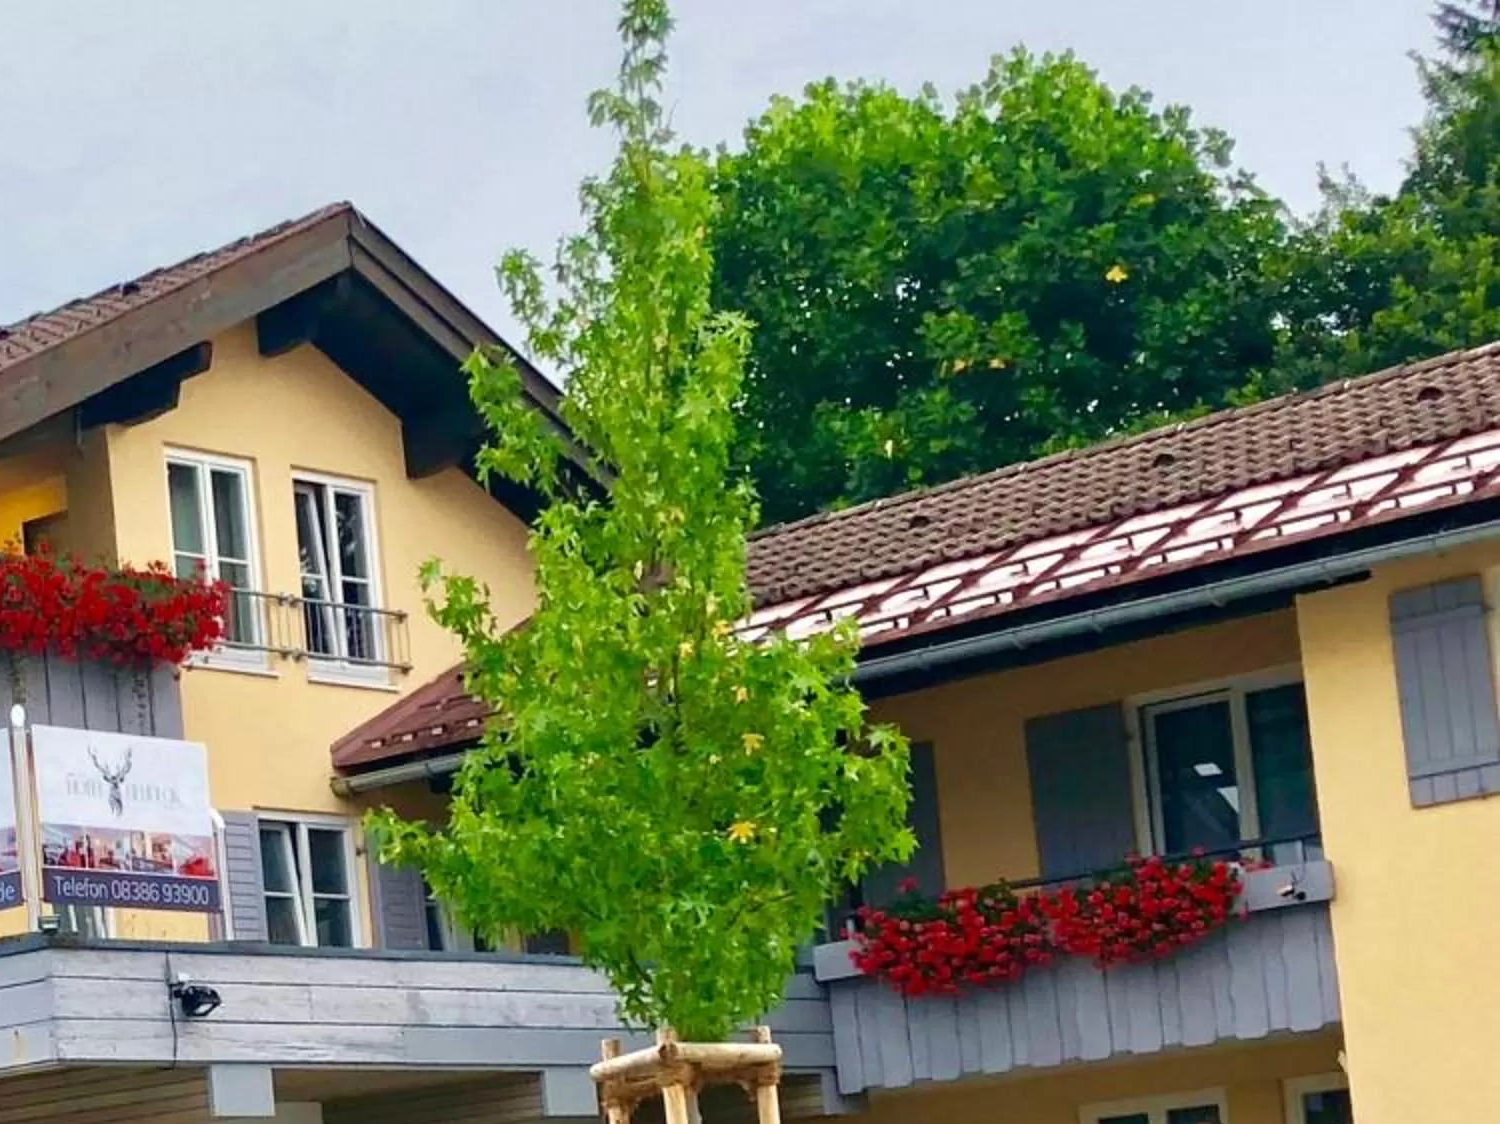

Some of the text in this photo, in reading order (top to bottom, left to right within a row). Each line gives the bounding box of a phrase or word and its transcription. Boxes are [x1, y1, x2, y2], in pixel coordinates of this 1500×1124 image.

[53, 876, 209, 906] Telefon 08386 93900
